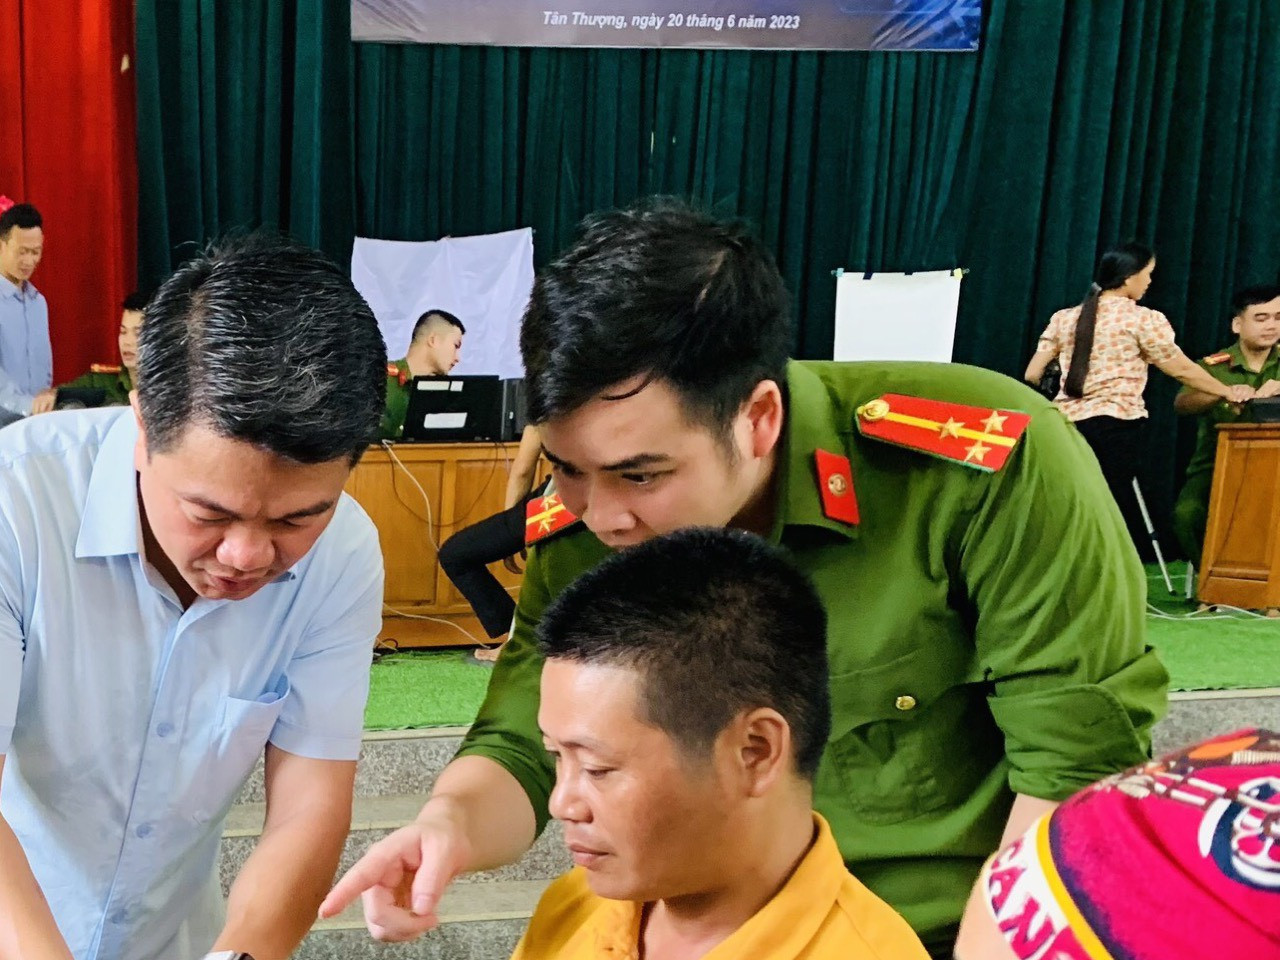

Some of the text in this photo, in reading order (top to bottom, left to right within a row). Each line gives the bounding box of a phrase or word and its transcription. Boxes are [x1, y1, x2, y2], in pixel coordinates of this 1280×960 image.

[543, 11, 800, 31] Tân Thượng, ngày 20 tháng 6 năm 2023
